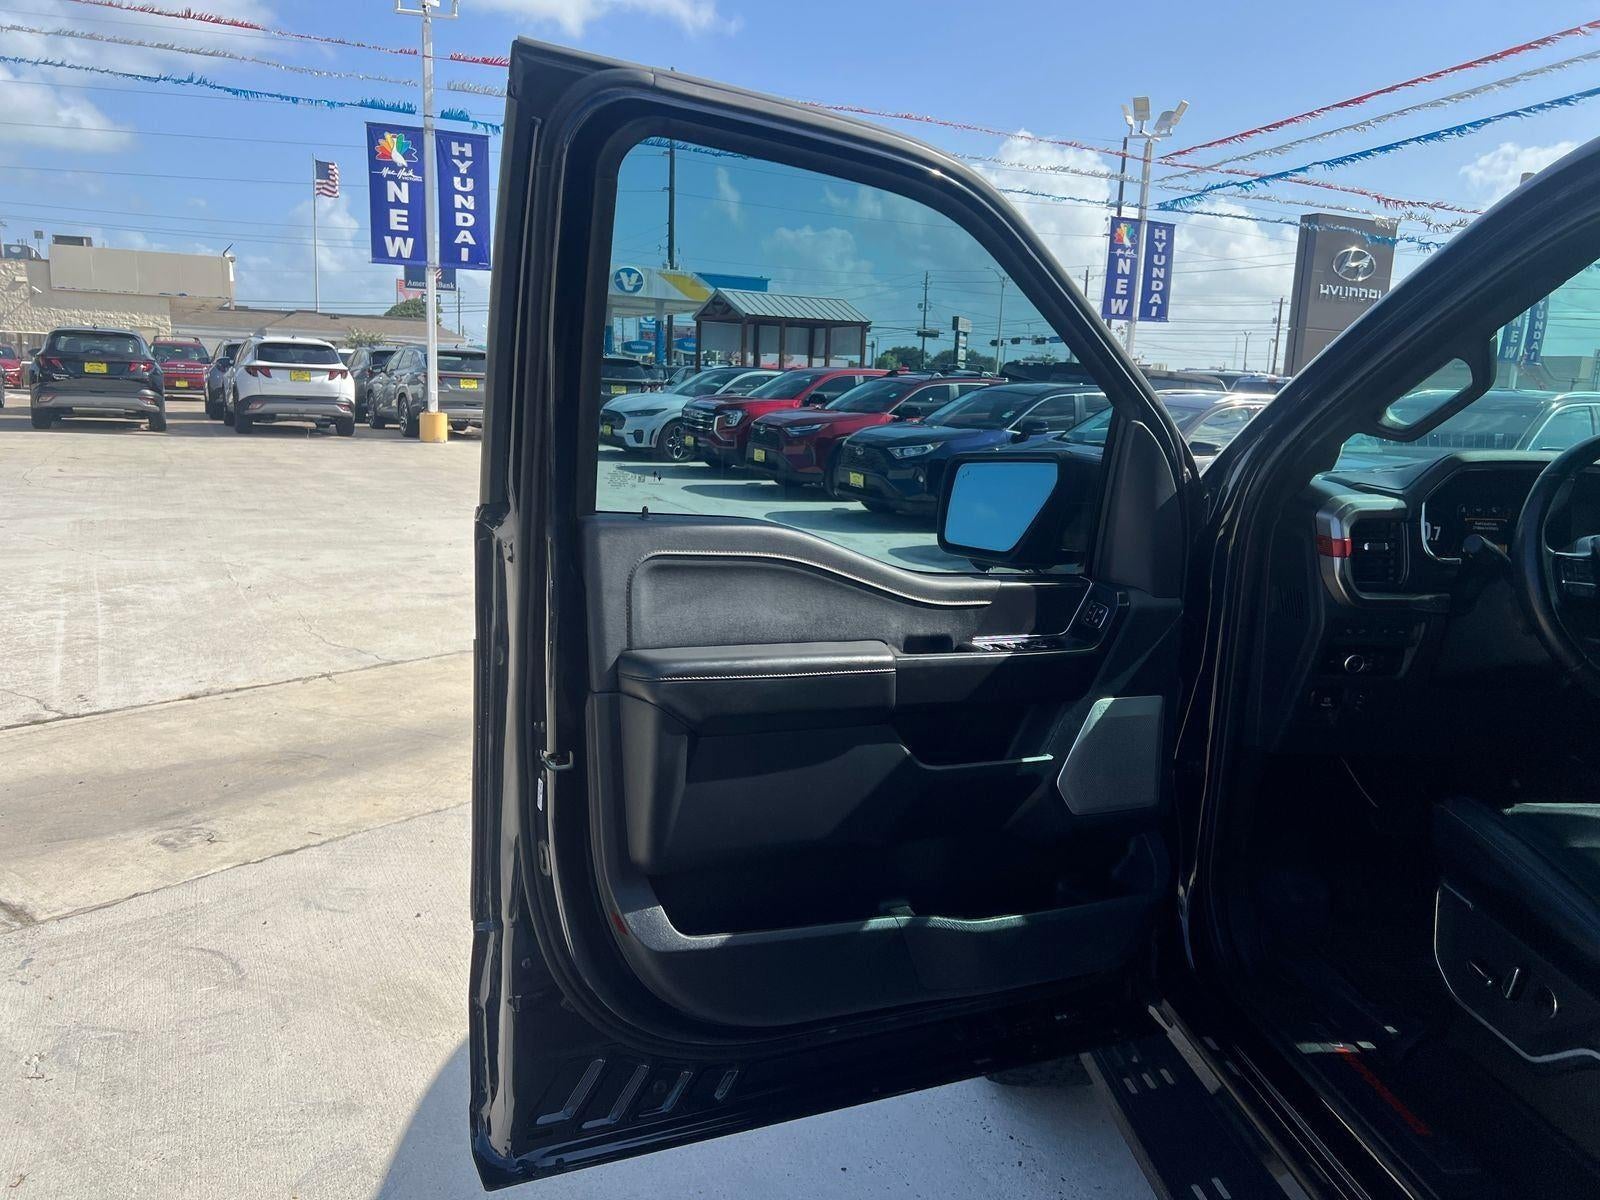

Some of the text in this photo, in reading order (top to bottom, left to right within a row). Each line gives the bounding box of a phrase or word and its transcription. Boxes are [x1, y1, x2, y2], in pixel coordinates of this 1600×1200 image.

[384, 180, 414, 259] NEW
[451, 141, 476, 262] HYUNDAI
[1110, 258, 1131, 315] NEW
[1149, 228, 1167, 317] HYUNDAI
[1320, 283, 1382, 301] HYUNDAI
